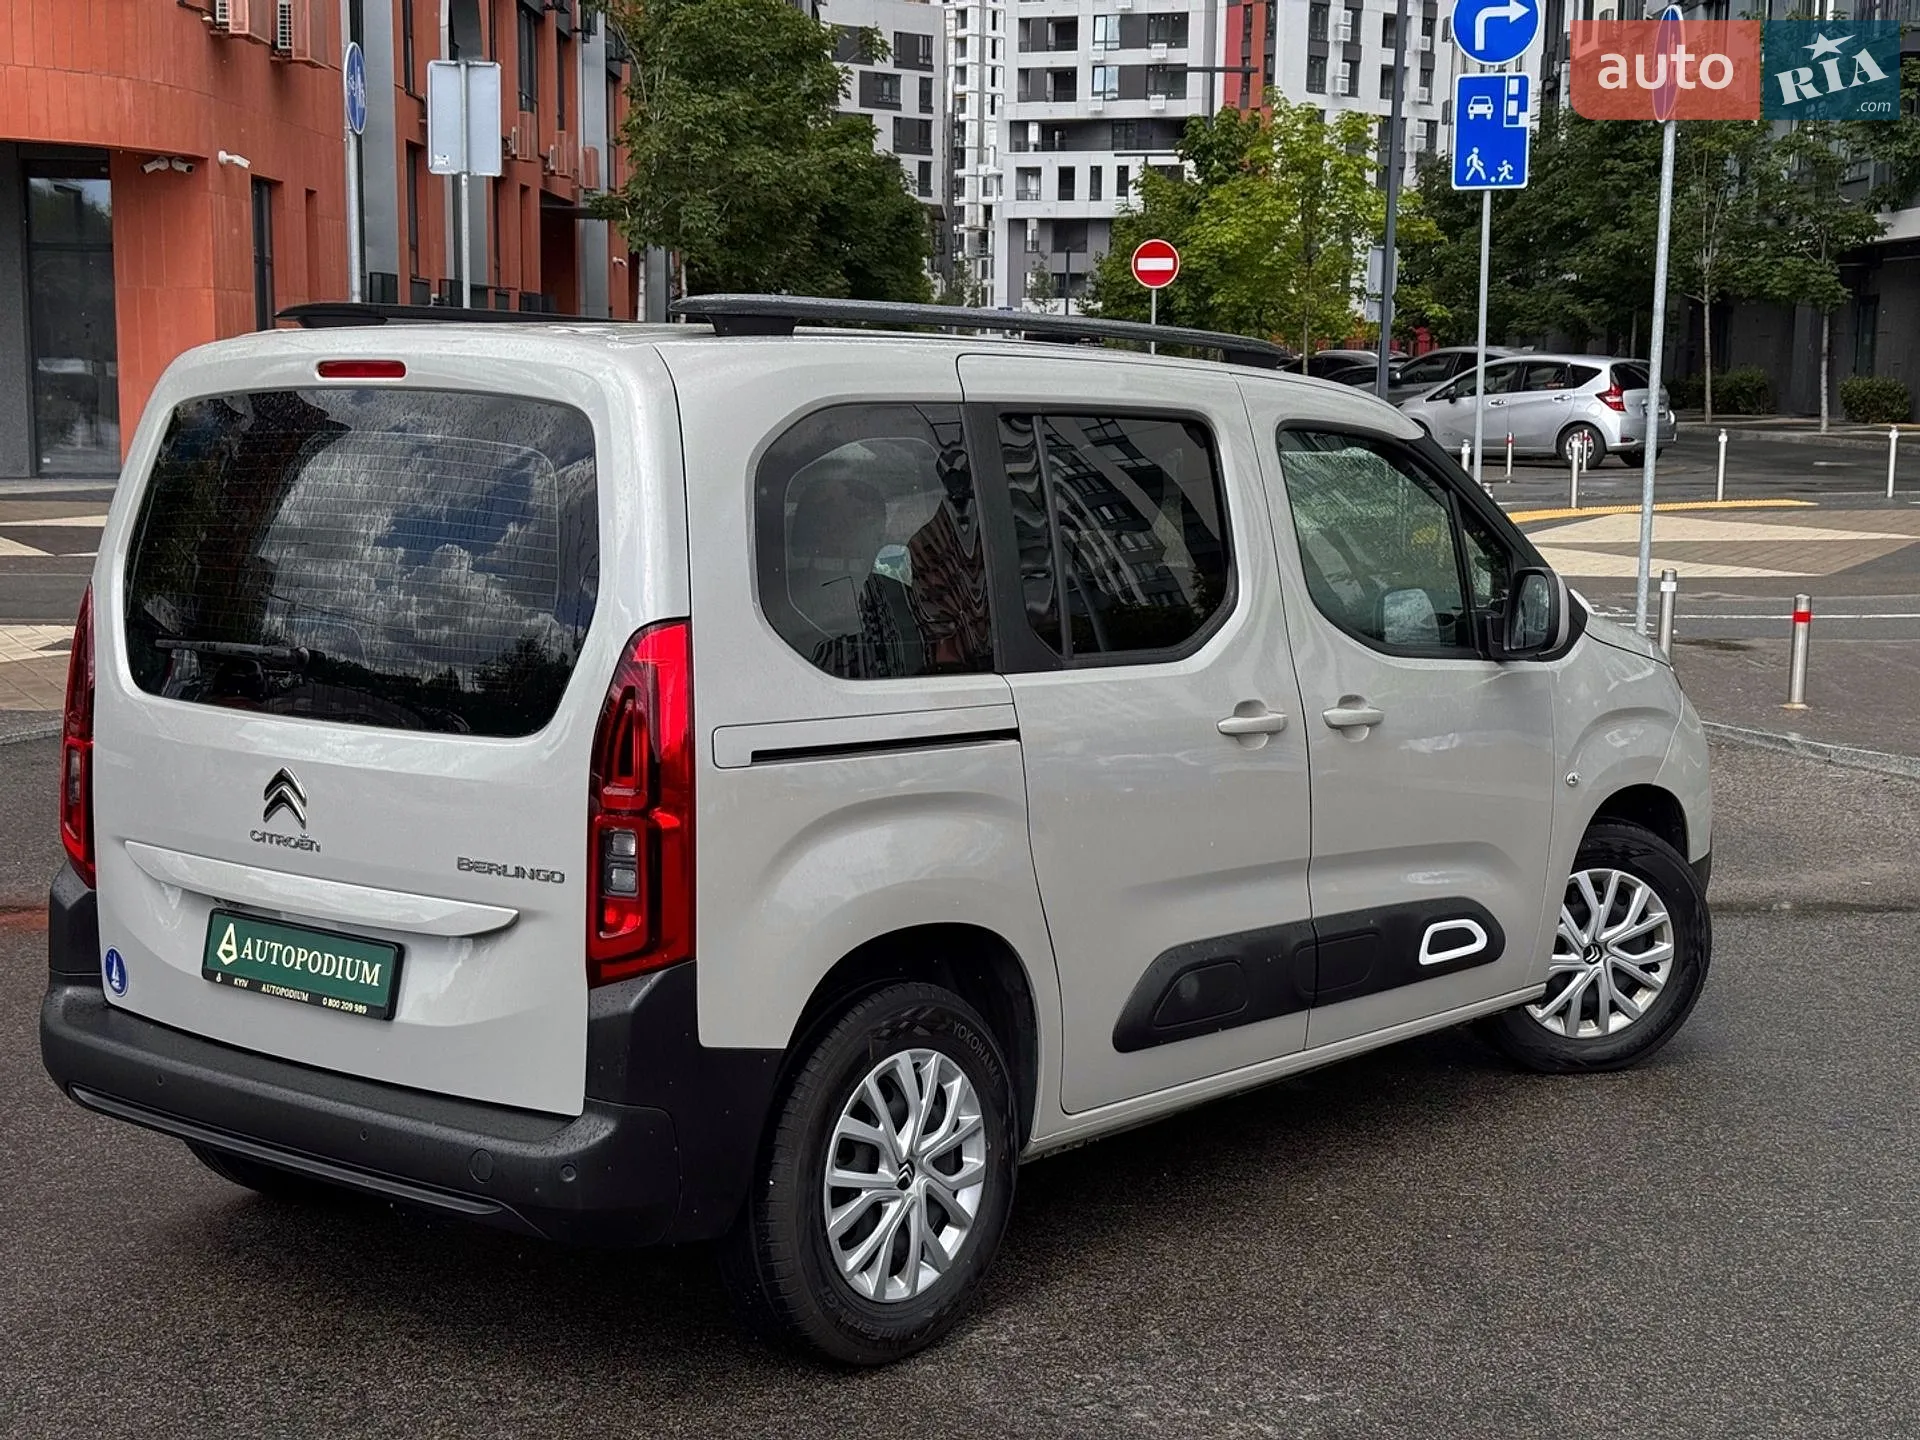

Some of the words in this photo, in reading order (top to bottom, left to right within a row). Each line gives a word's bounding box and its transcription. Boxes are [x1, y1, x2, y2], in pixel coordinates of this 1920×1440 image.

[457, 856, 566, 884] BERLINGO
[240, 937, 382, 987] AUTOPODIUM
[233, 977, 250, 988] KYIV
[260, 983, 310, 1002] AUTOPODIUM
[322, 997, 328, 1006] 0
[328, 998, 341, 1008] 800
